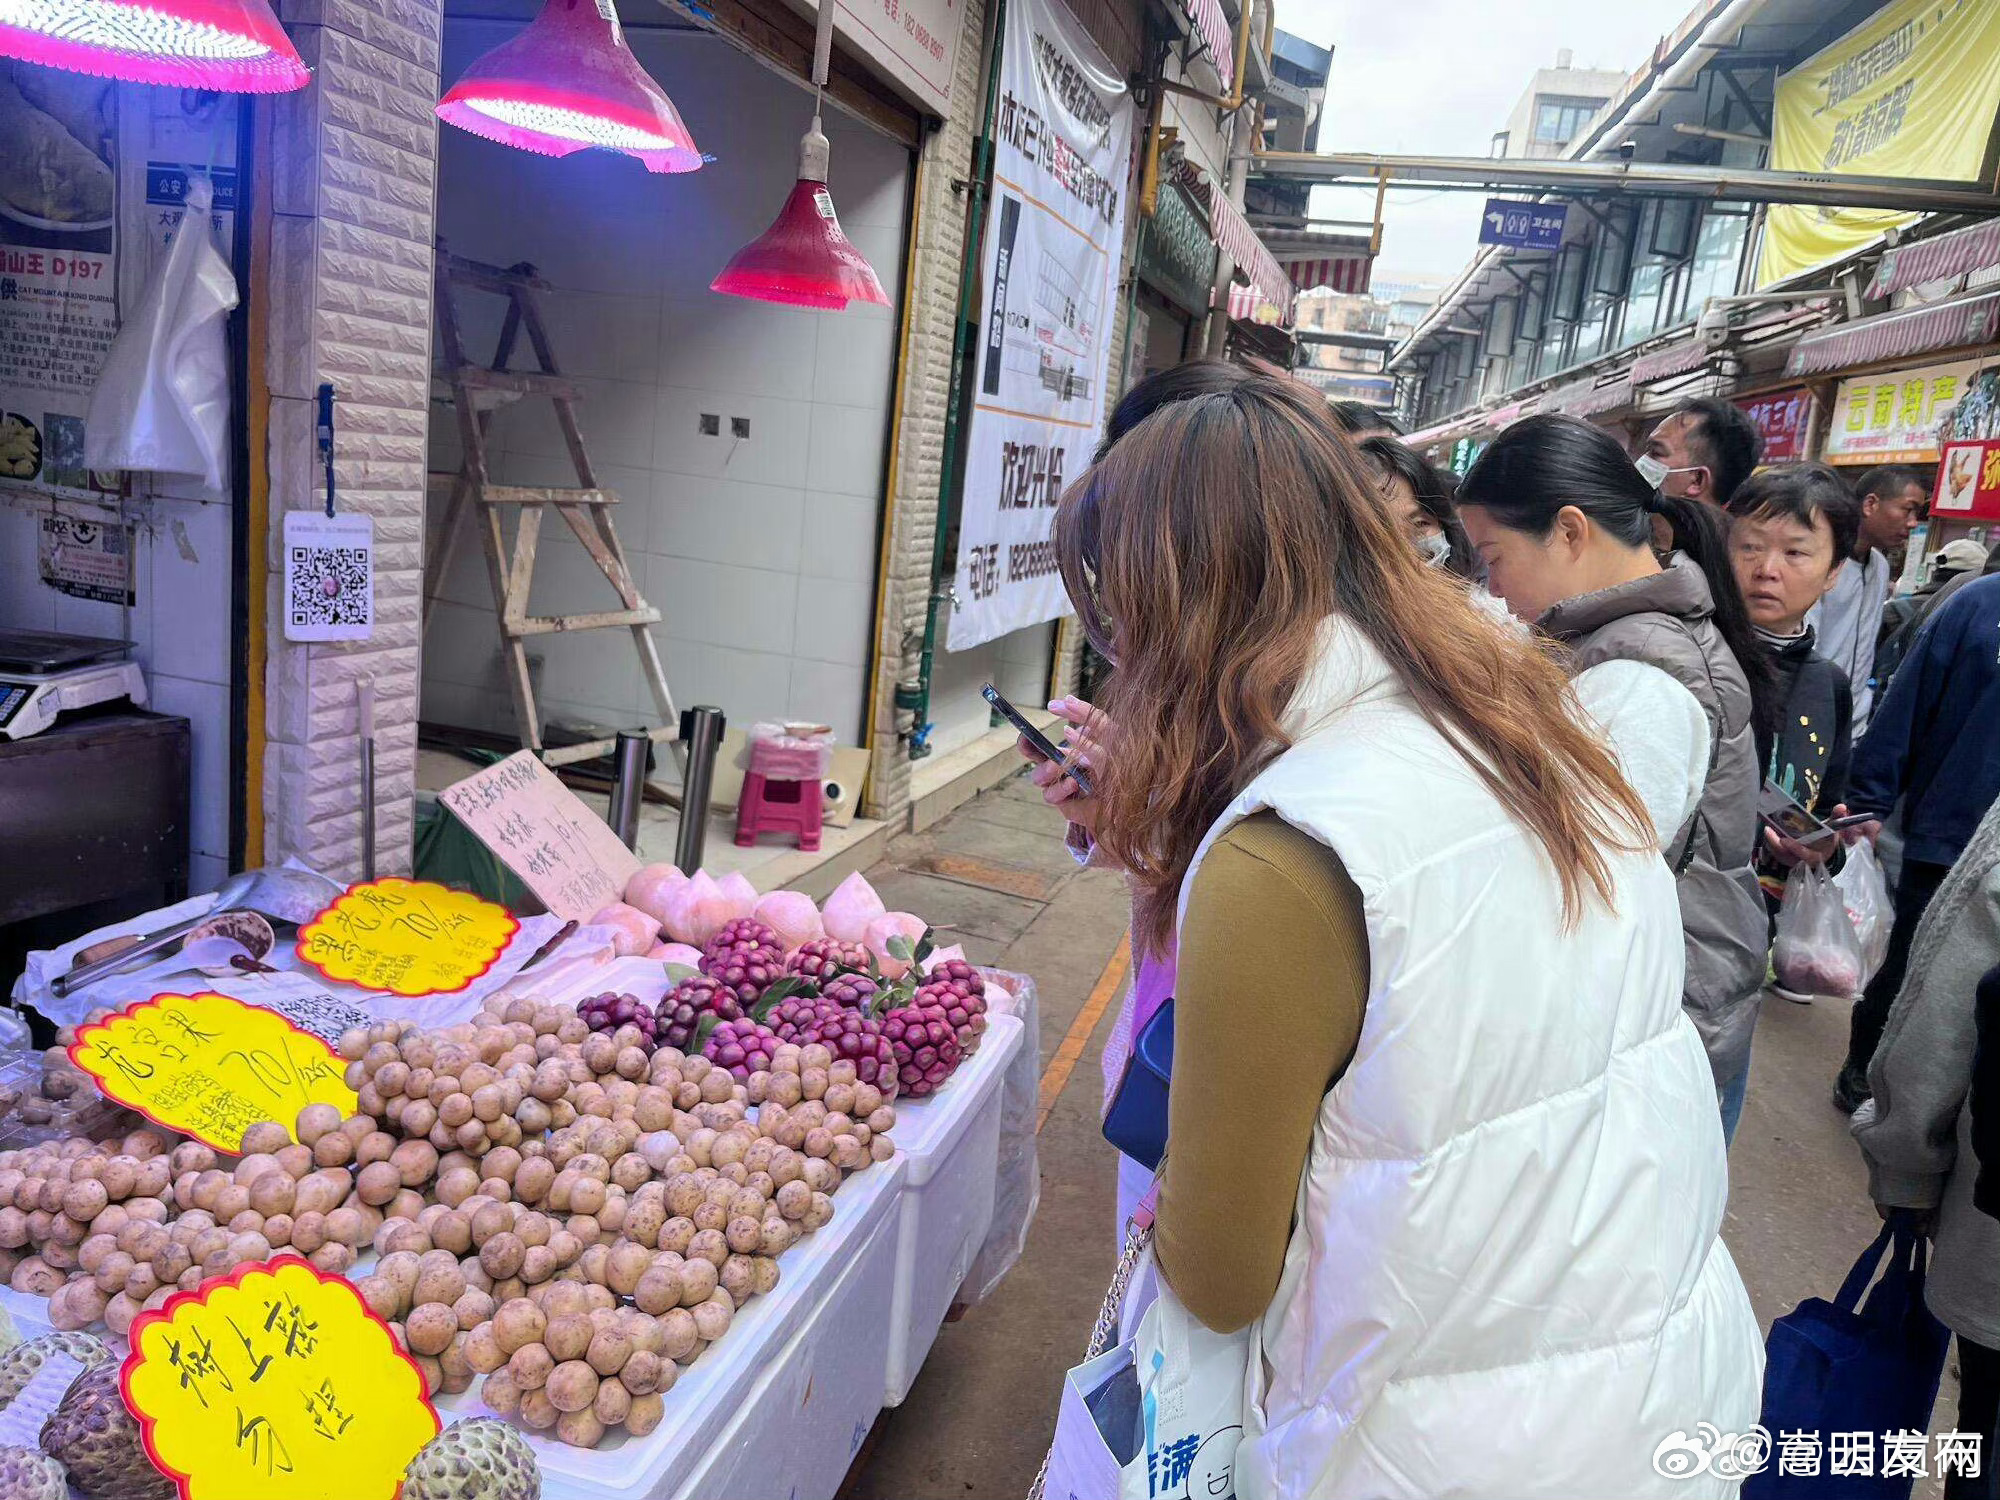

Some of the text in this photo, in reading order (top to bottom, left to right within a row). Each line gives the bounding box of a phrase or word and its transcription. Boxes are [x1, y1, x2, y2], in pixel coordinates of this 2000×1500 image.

[160, 179, 181, 195] 公安
[1532, 217, 1562, 230] 卫生间
[52, 257, 104, 279] D197
[1845, 375, 1959, 432] 云南特产
[999, 441, 1066, 511] 欢迎光临
